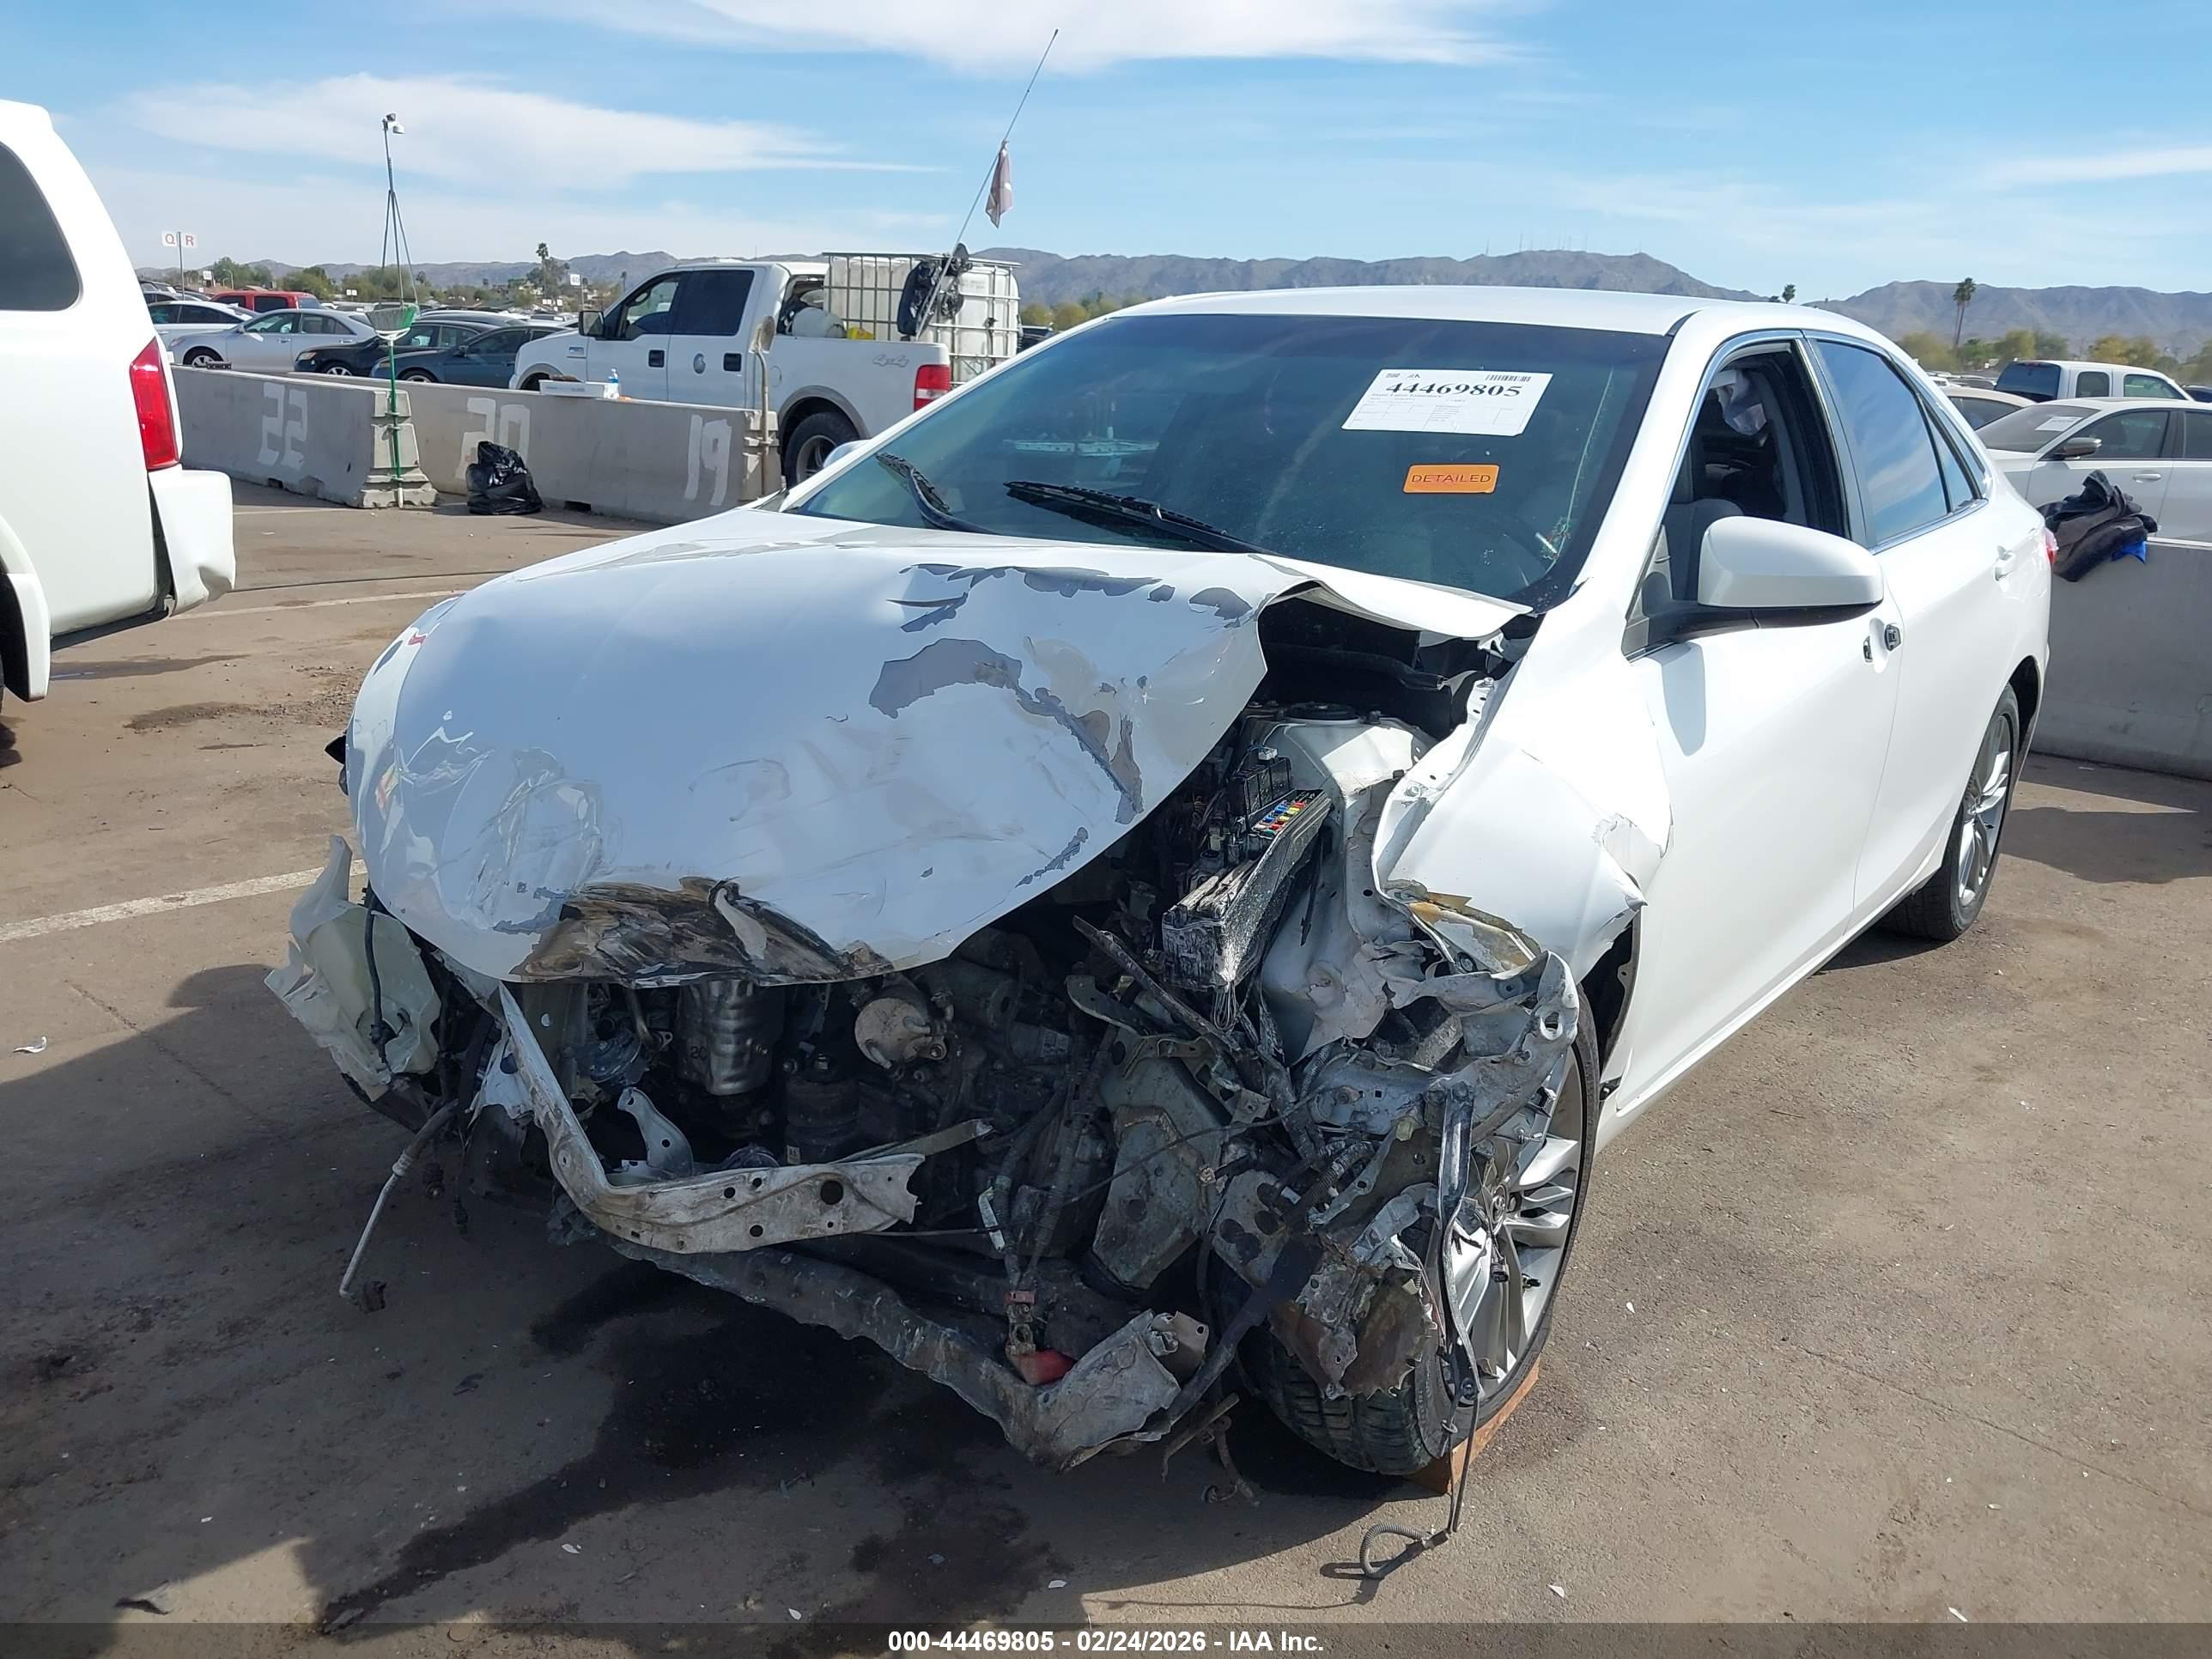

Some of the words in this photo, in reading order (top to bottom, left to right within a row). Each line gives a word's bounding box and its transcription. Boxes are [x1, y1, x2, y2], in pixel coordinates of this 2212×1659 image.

[165, 234, 175, 244] Q
[185, 235, 194, 246] R
[1385, 382, 1523, 397] 44469805
[258, 381, 307, 471] 22
[456, 398, 531, 480] 20
[684, 414, 732, 507] 19
[1411, 474, 1492, 483] DETAILED
